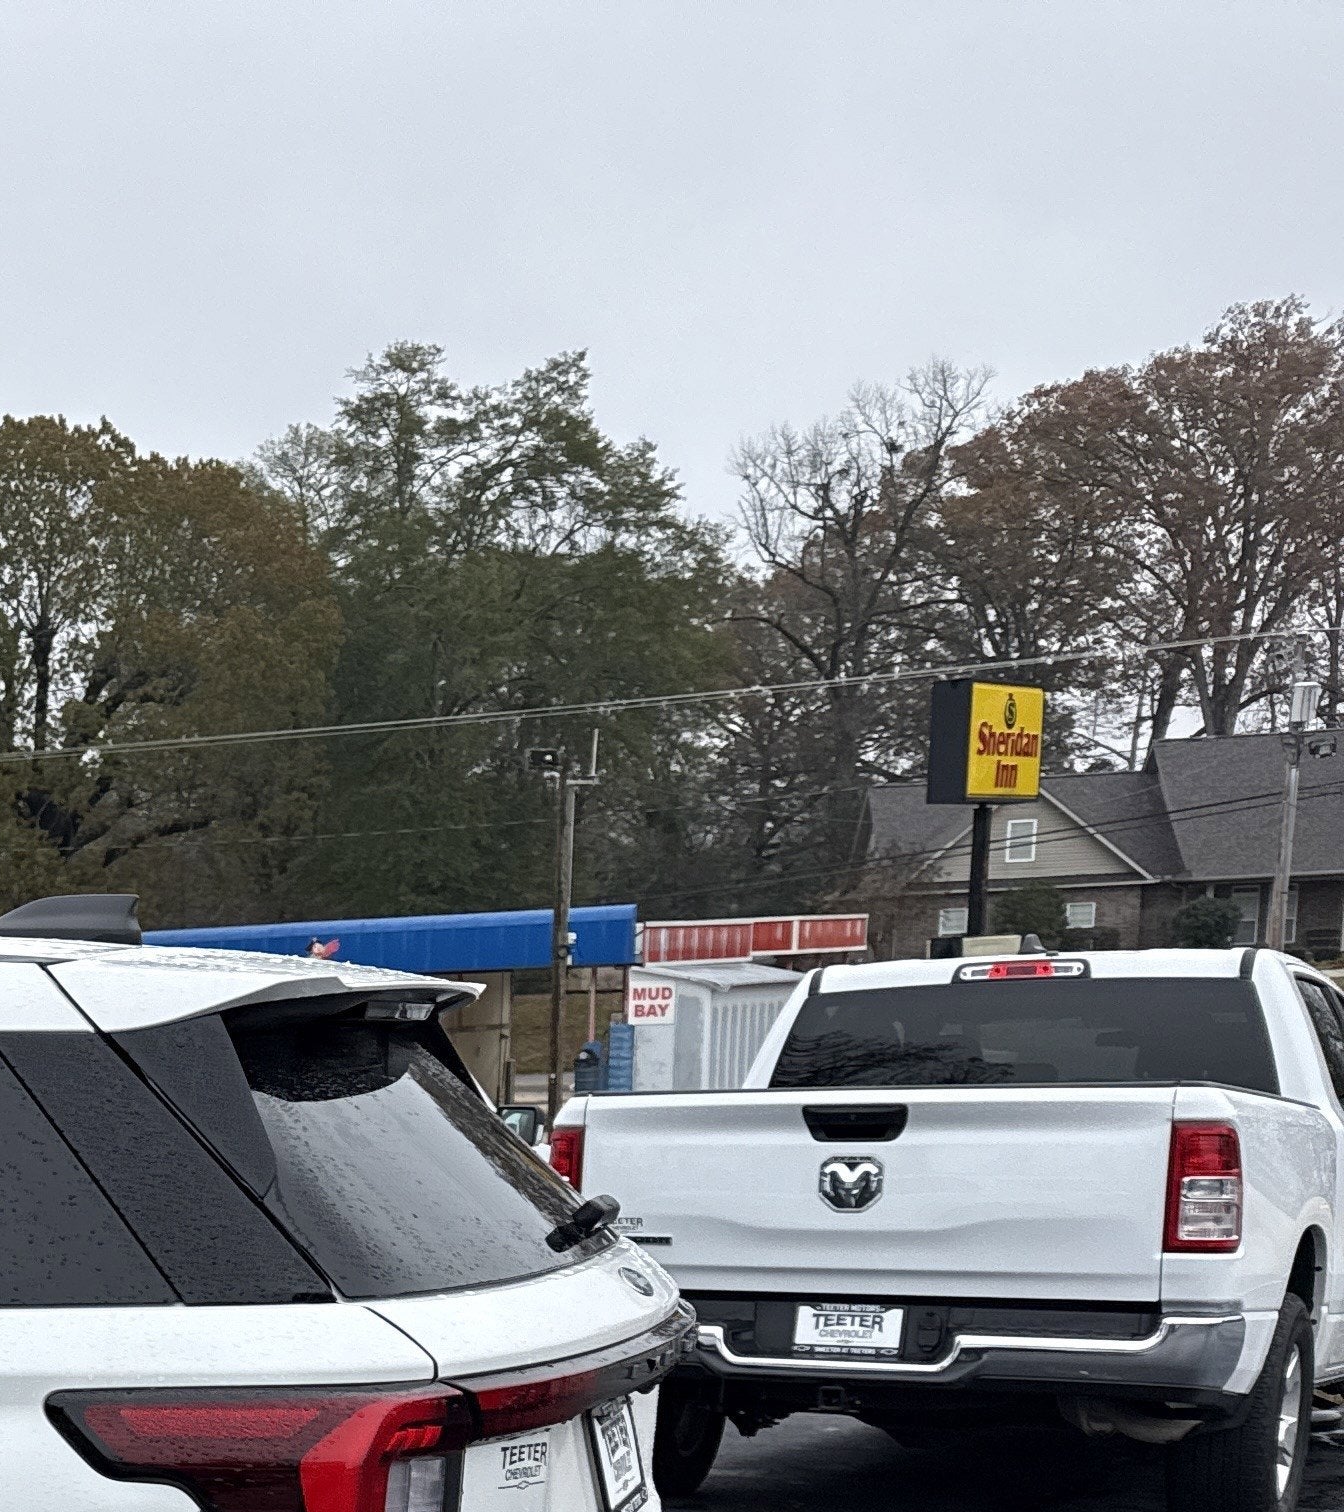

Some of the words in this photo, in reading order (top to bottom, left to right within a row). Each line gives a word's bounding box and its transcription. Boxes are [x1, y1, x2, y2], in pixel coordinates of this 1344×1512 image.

[977, 722, 1039, 757] Sheridan
[994, 760, 1018, 788] Inn
[632, 987, 673, 1001] MUD
[634, 1004, 669, 1018] BAY
[813, 1313, 885, 1333] TEETER
[819, 1329, 874, 1339] CHEVROLET
[501, 1442, 548, 1469] TEETER
